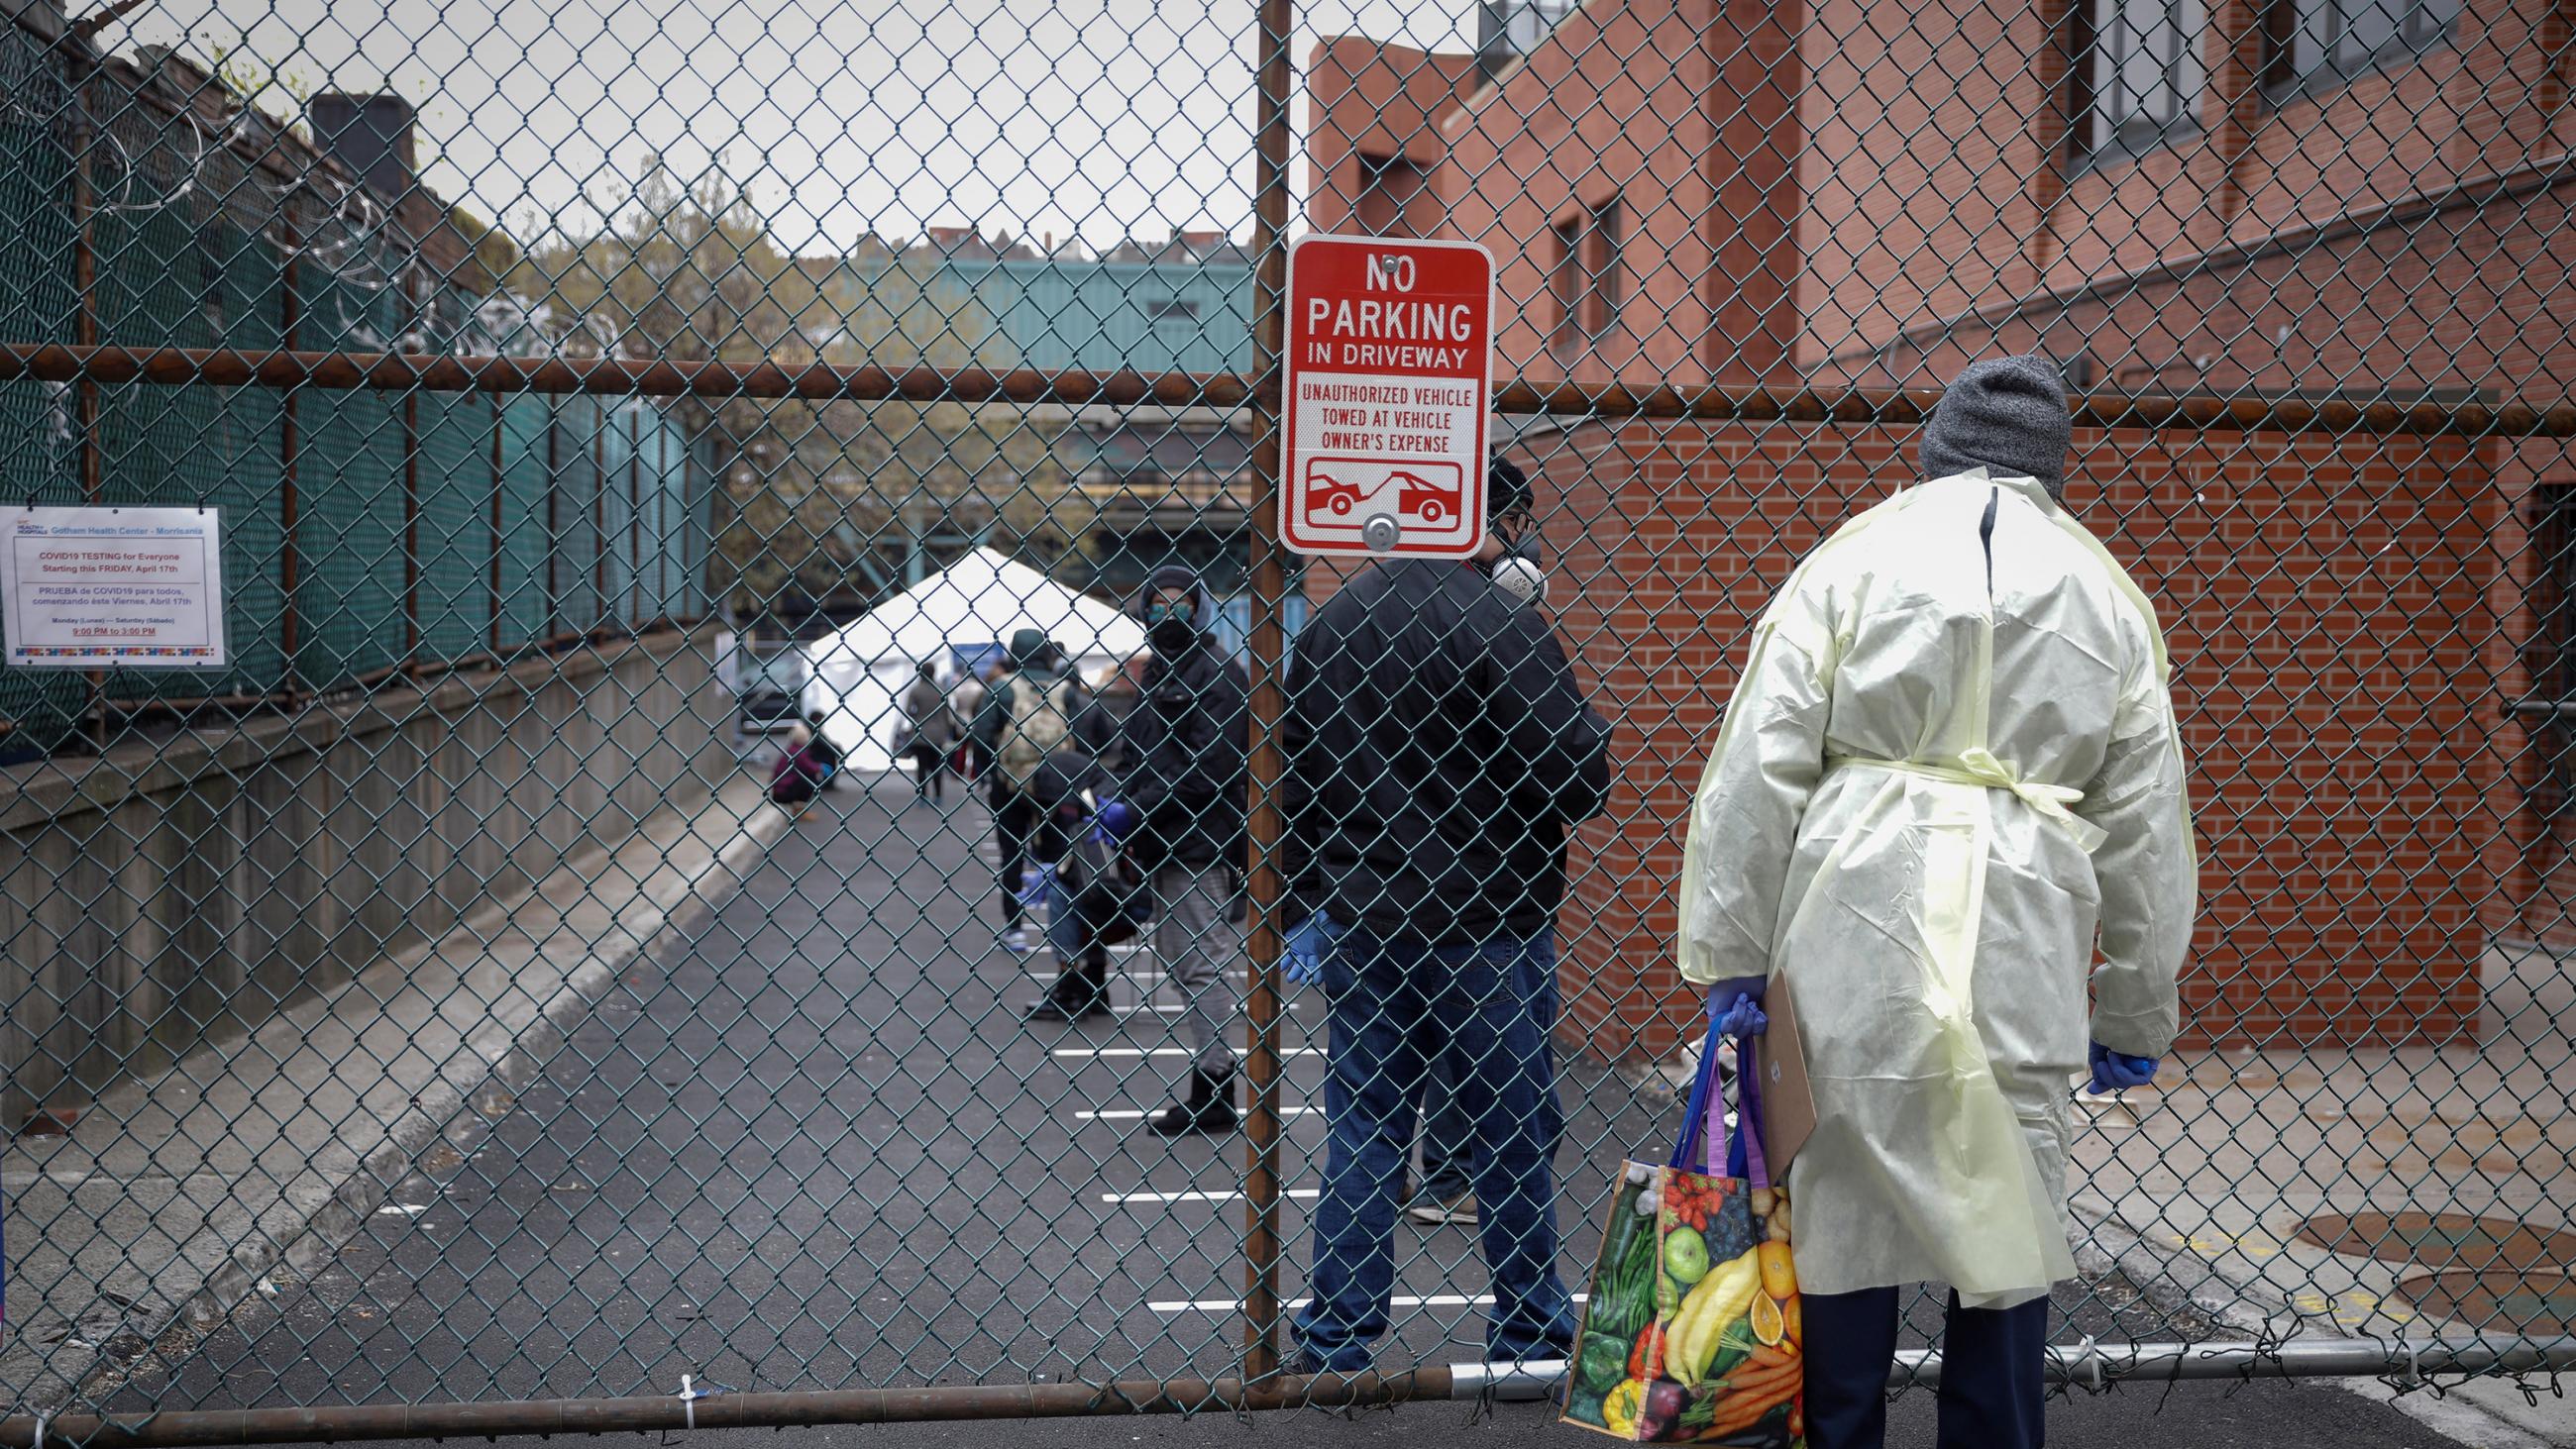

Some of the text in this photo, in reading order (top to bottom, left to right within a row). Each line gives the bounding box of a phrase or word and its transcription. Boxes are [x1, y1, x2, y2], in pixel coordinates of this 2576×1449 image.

[1366, 254, 1416, 292] NO
[1308, 298, 1471, 342] PARKING
[1308, 342, 1468, 369] IN DRIVEWAY
[1303, 384, 1471, 406] UNAUTHORIZED VEHICLE
[1322, 408, 1450, 429] TOWED AT VEHICLE
[1322, 433, 1449, 453] OWNER'S EXPENSE
